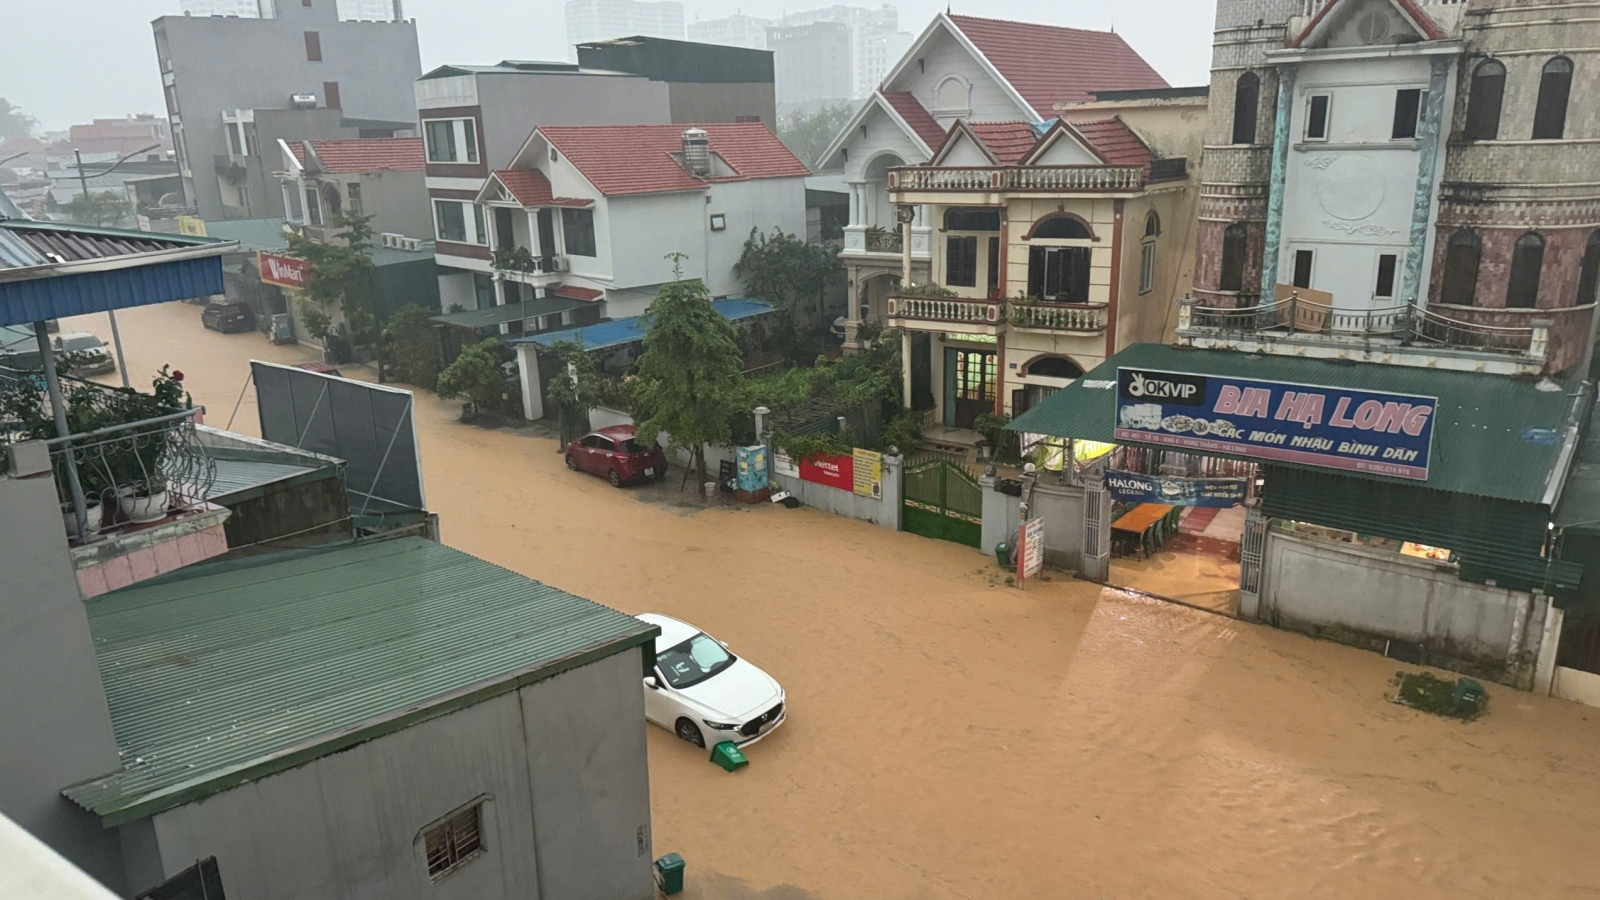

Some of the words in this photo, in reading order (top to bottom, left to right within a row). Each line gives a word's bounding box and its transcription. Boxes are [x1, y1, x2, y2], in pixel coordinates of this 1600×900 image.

[1145, 380, 1197, 398] OKVIP
[1213, 385, 1271, 418] BIA
[1274, 391, 1325, 429] HẠ
[1328, 397, 1433, 436] LONG
[1248, 429, 1287, 445] MÓN
[1290, 436, 1334, 451] NHẬU
[1337, 439, 1379, 456] BÌNH
[813, 460, 839, 472] viettel
[1108, 478, 1153, 491] HALONG
[1119, 488, 1145, 496] LEGEND
